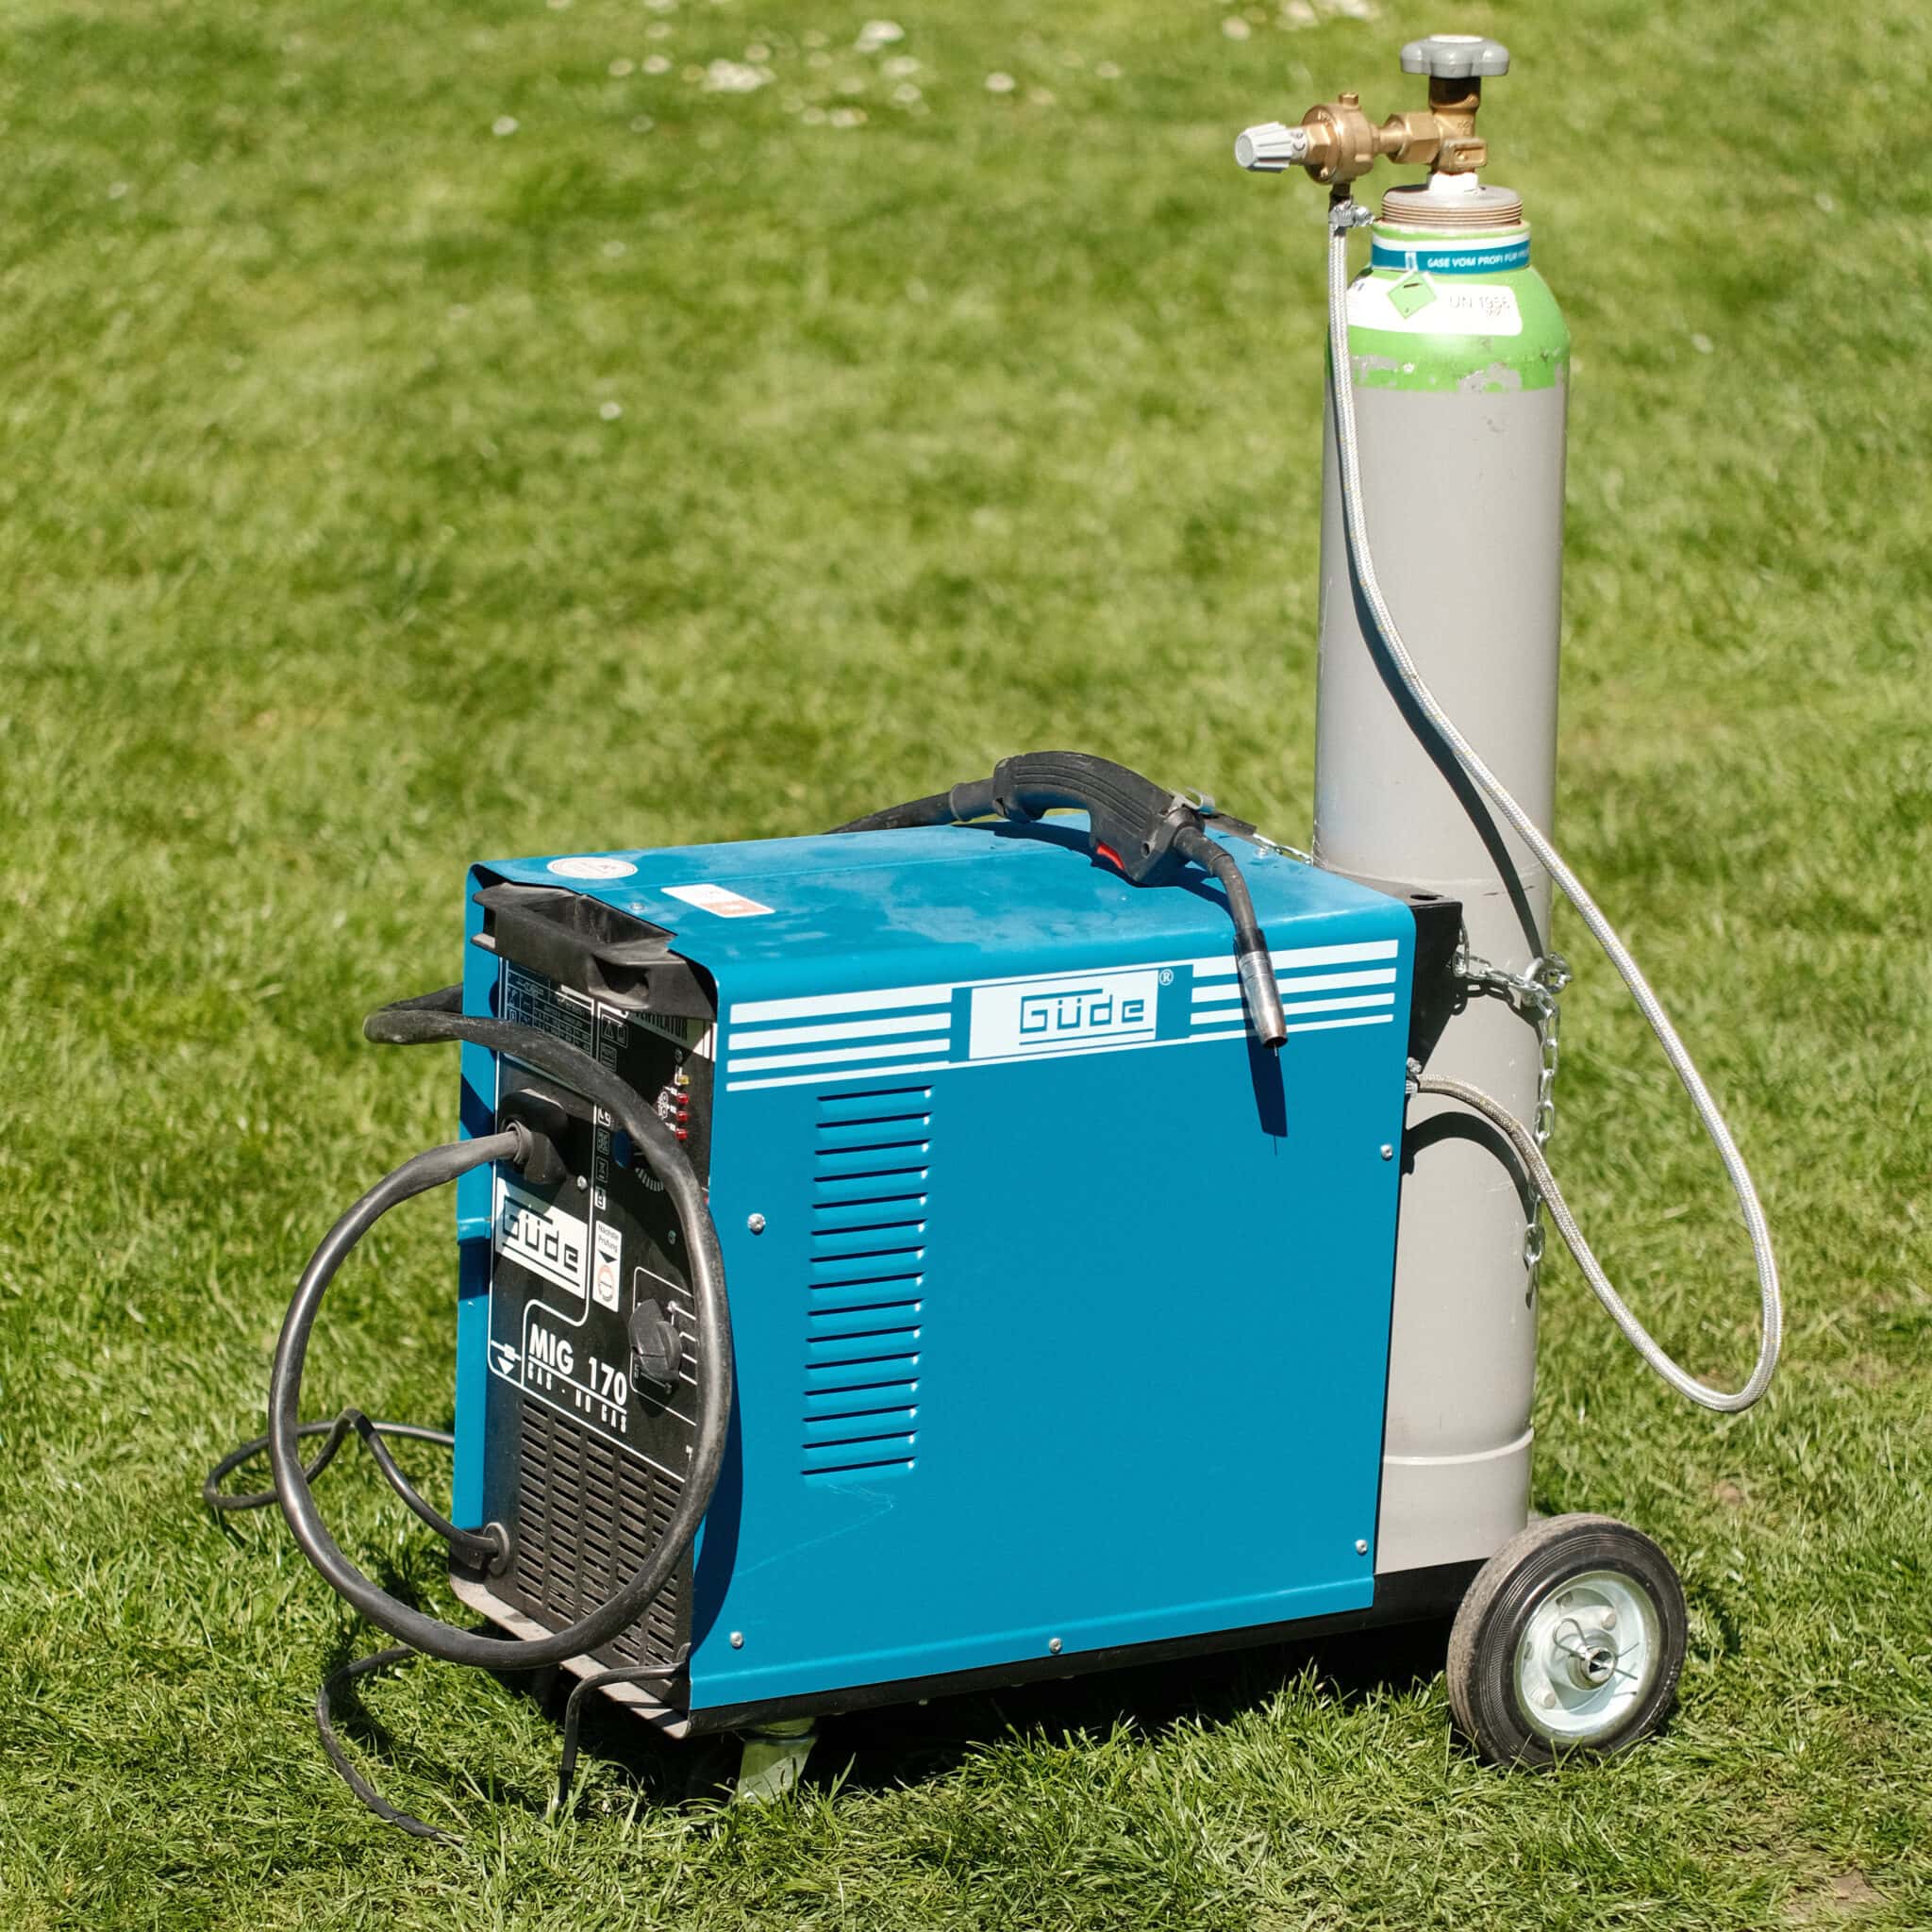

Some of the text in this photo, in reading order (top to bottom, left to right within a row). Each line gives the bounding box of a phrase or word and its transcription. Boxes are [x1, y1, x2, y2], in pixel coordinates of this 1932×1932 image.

[1427, 258, 1450, 268] GASE
[1452, 256, 1476, 267] VOM
[1477, 254, 1503, 265] PROFI
[1449, 294, 1474, 309] UN
[1019, 988, 1145, 1034] Güde
[502, 1194, 579, 1274] Güde
[528, 1323, 627, 1407] MIG 170
[527, 1361, 627, 1433] GAS NO GAS
